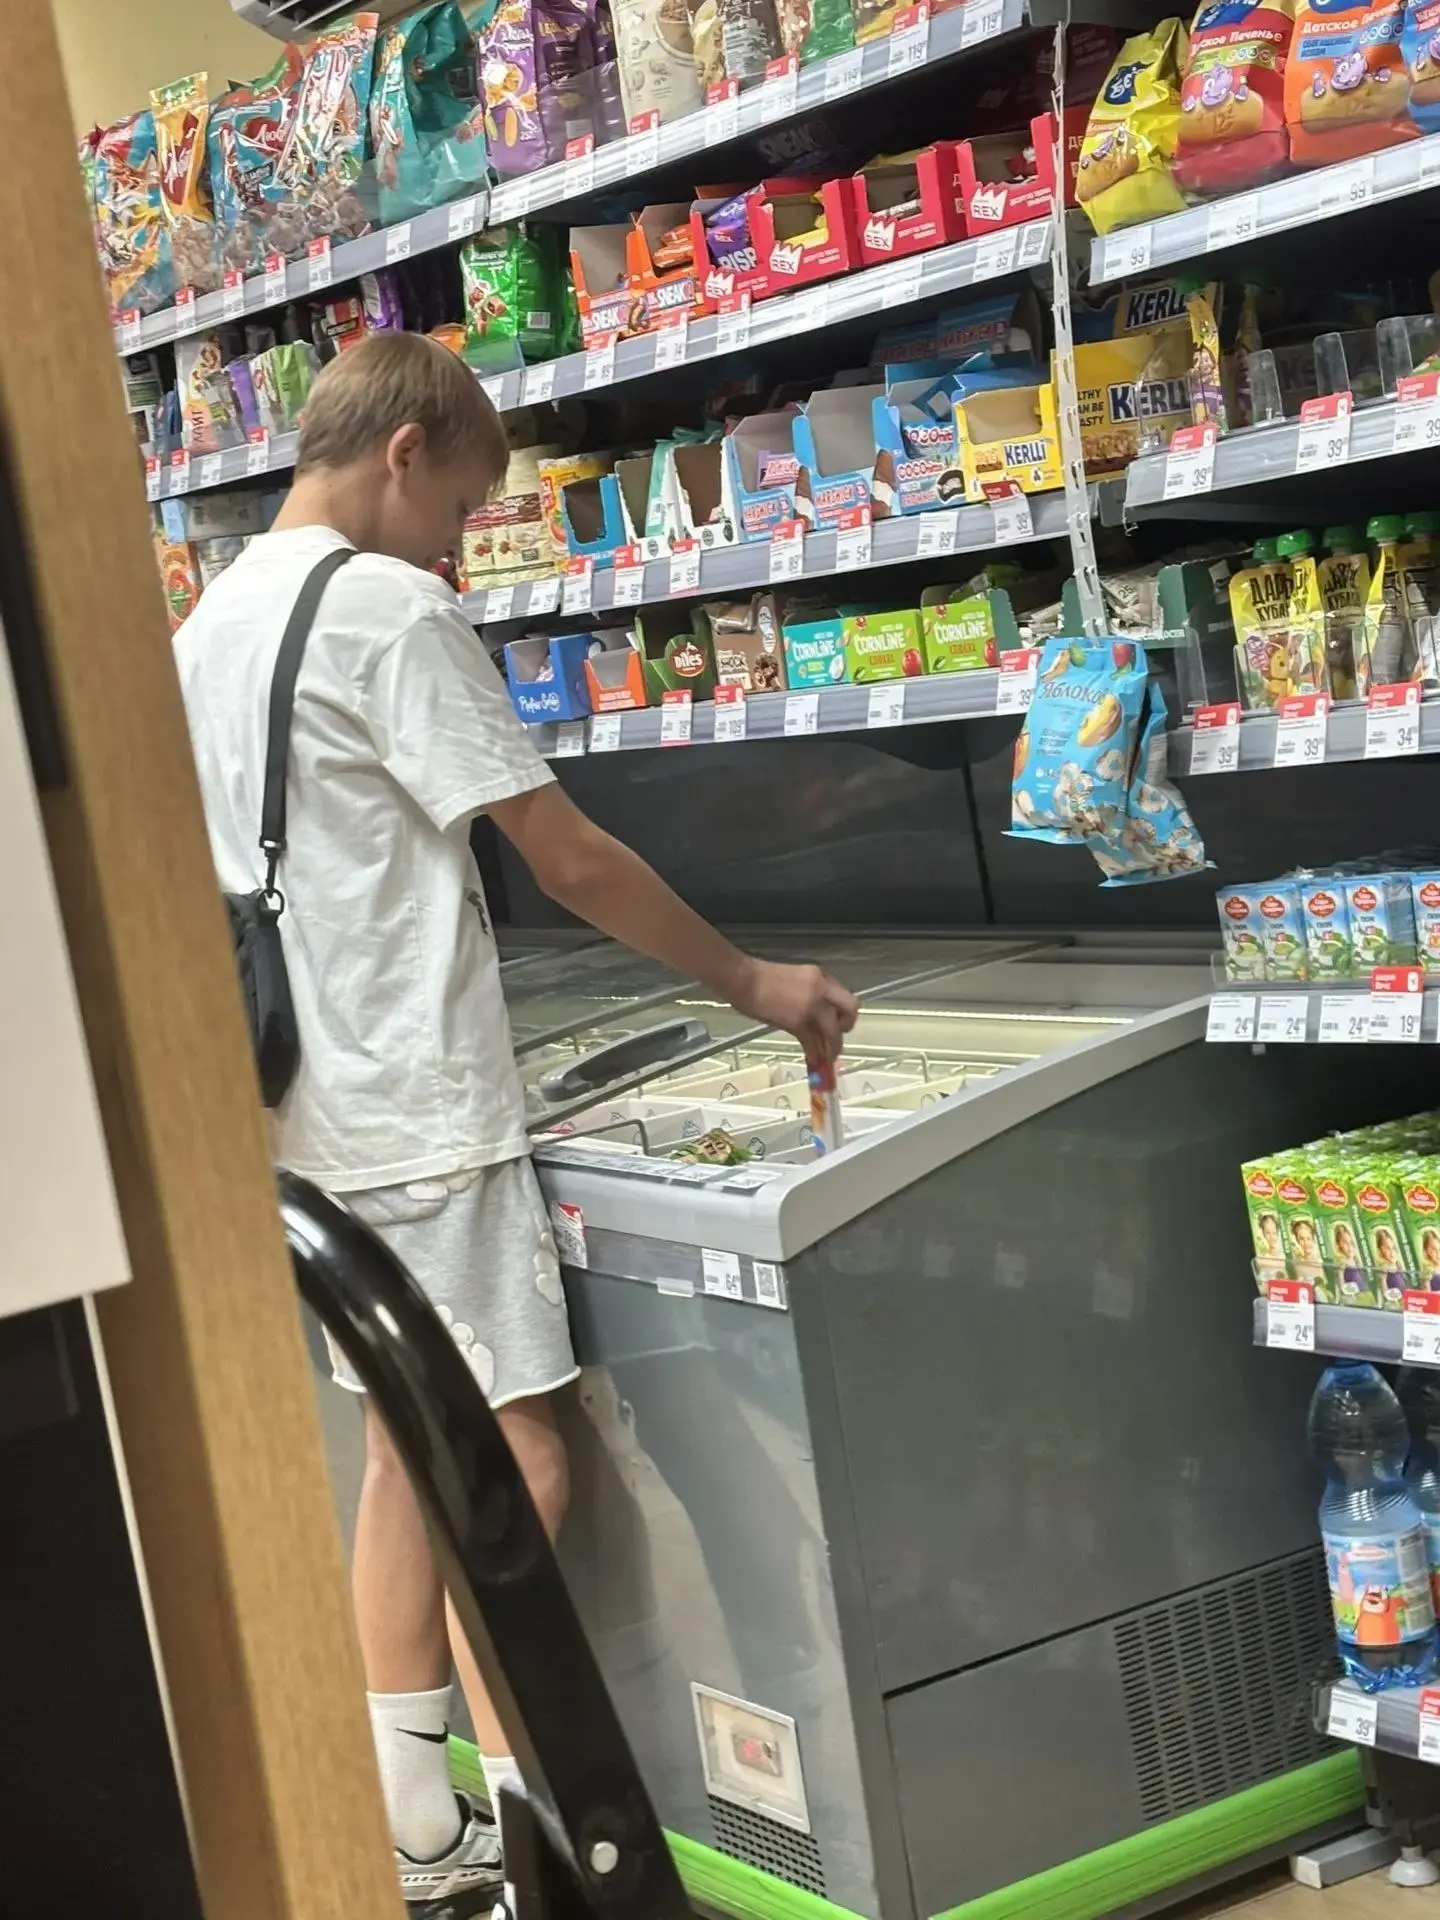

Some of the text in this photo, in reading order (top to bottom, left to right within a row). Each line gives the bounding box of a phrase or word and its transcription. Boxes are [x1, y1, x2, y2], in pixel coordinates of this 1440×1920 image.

[973, 205, 1000, 218] REX
[866, 234, 889, 249] REX
[1126, 288, 1187, 327] KERLL
[1091, 401, 1104, 412] BE
[1079, 415, 1104, 427] ASTY
[1304, 738, 1318, 756] 39
